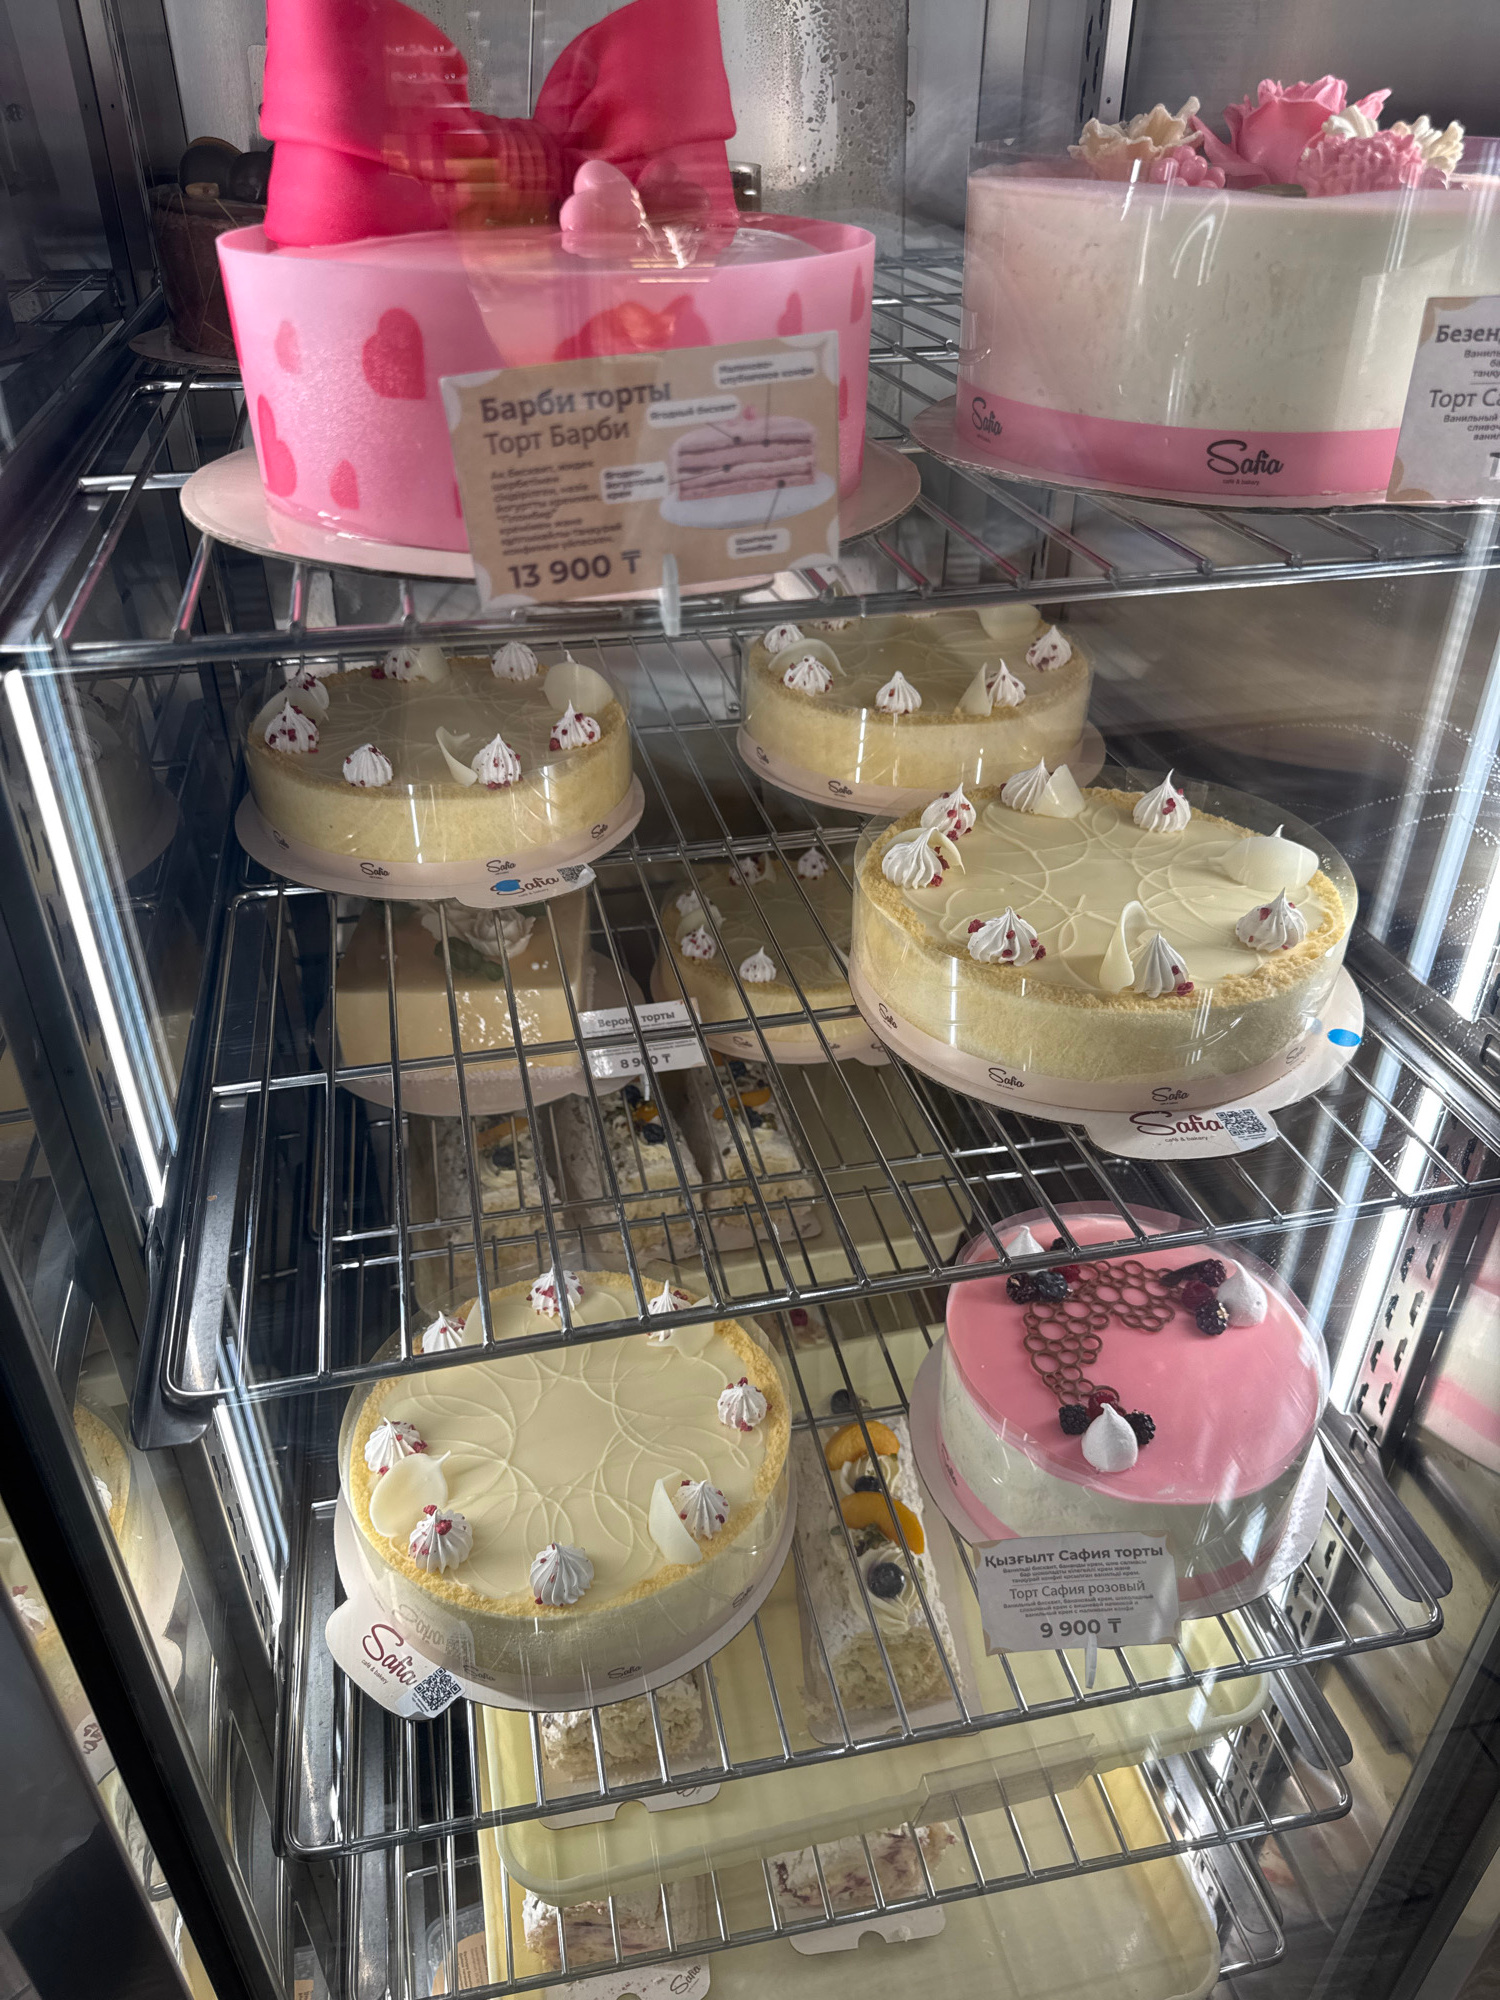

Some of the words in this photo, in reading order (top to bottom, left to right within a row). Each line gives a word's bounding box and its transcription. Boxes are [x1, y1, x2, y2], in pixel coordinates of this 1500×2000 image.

[1435, 325, 1500, 345] Безен
[479, 388, 576, 424] Барби
[583, 382, 671, 414] торты
[1429, 389, 1478, 412] Торт
[971, 396, 1003, 436] Safia
[1443, 413, 1498, 423] Ванильный
[484, 430, 542, 458] Торт
[550, 416, 630, 452] Барби
[1206, 439, 1284, 475] Safia
[509, 562, 541, 589] 13
[549, 554, 612, 584] 900
[360, 862, 390, 876] Safia
[486, 859, 516, 873] Safia
[598, 1017, 634, 1029] Верон
[641, 1012, 675, 1023] торты
[620, 1060, 629, 1069] 8
[988, 1067, 1025, 1088] Safia
[1151, 1087, 1190, 1102] Safia
[1129, 1110, 1224, 1135] Safia
[985, 1553, 1055, 1568] Қызғылт
[1059, 1548, 1110, 1562] Сафия
[1114, 1547, 1163, 1560] торты
[1009, 1589, 1038, 1601] Торт
[1042, 1584, 1085, 1598] Сафия
[1088, 1580, 1145, 1596] розовый
[1040, 1622, 1054, 1638] 9
[1060, 1619, 1101, 1636] 900
[1108, 1618, 1121, 1633] ₸
[362, 1624, 417, 1685] Safia
[374, 1669, 388, 1684] bakery
